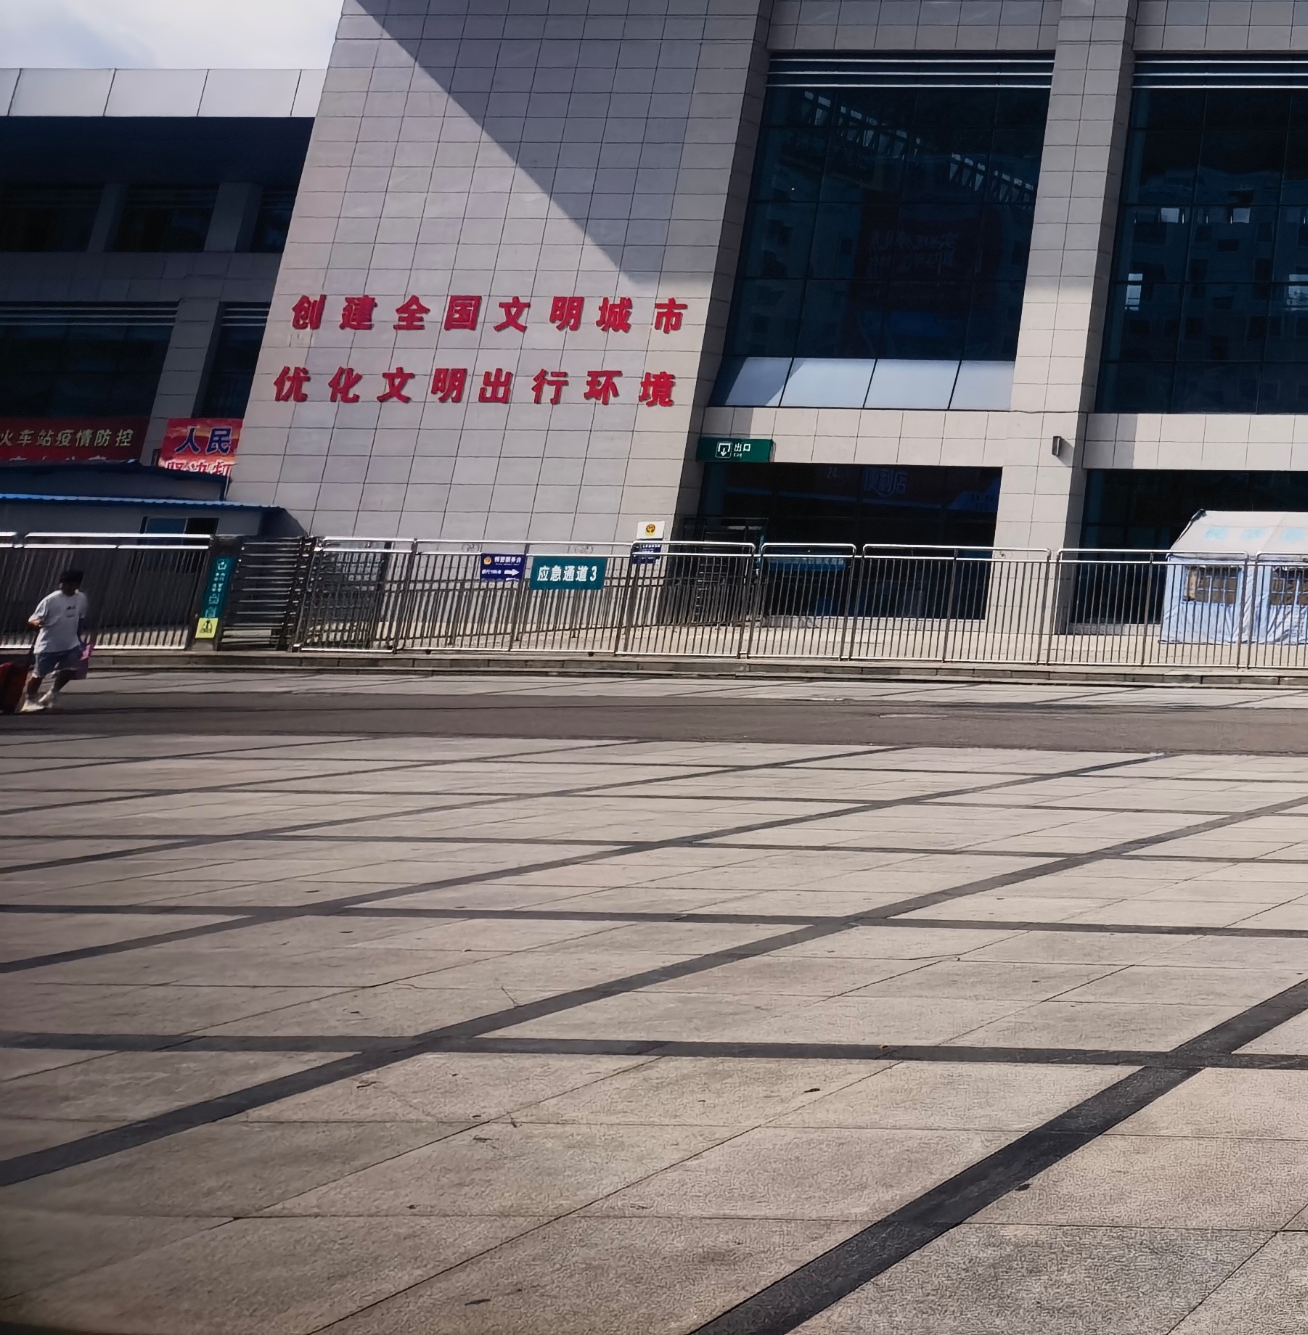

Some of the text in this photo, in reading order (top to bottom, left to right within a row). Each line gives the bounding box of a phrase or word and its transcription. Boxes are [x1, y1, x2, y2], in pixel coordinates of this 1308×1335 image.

[292, 295, 688, 334] 创建全国文明城市
[274, 366, 675, 407] 优化文明出行环境
[174, 426, 233, 454] 人民
[733, 442, 751, 452] 出口
[536, 565, 598, 582] 应急通道3
